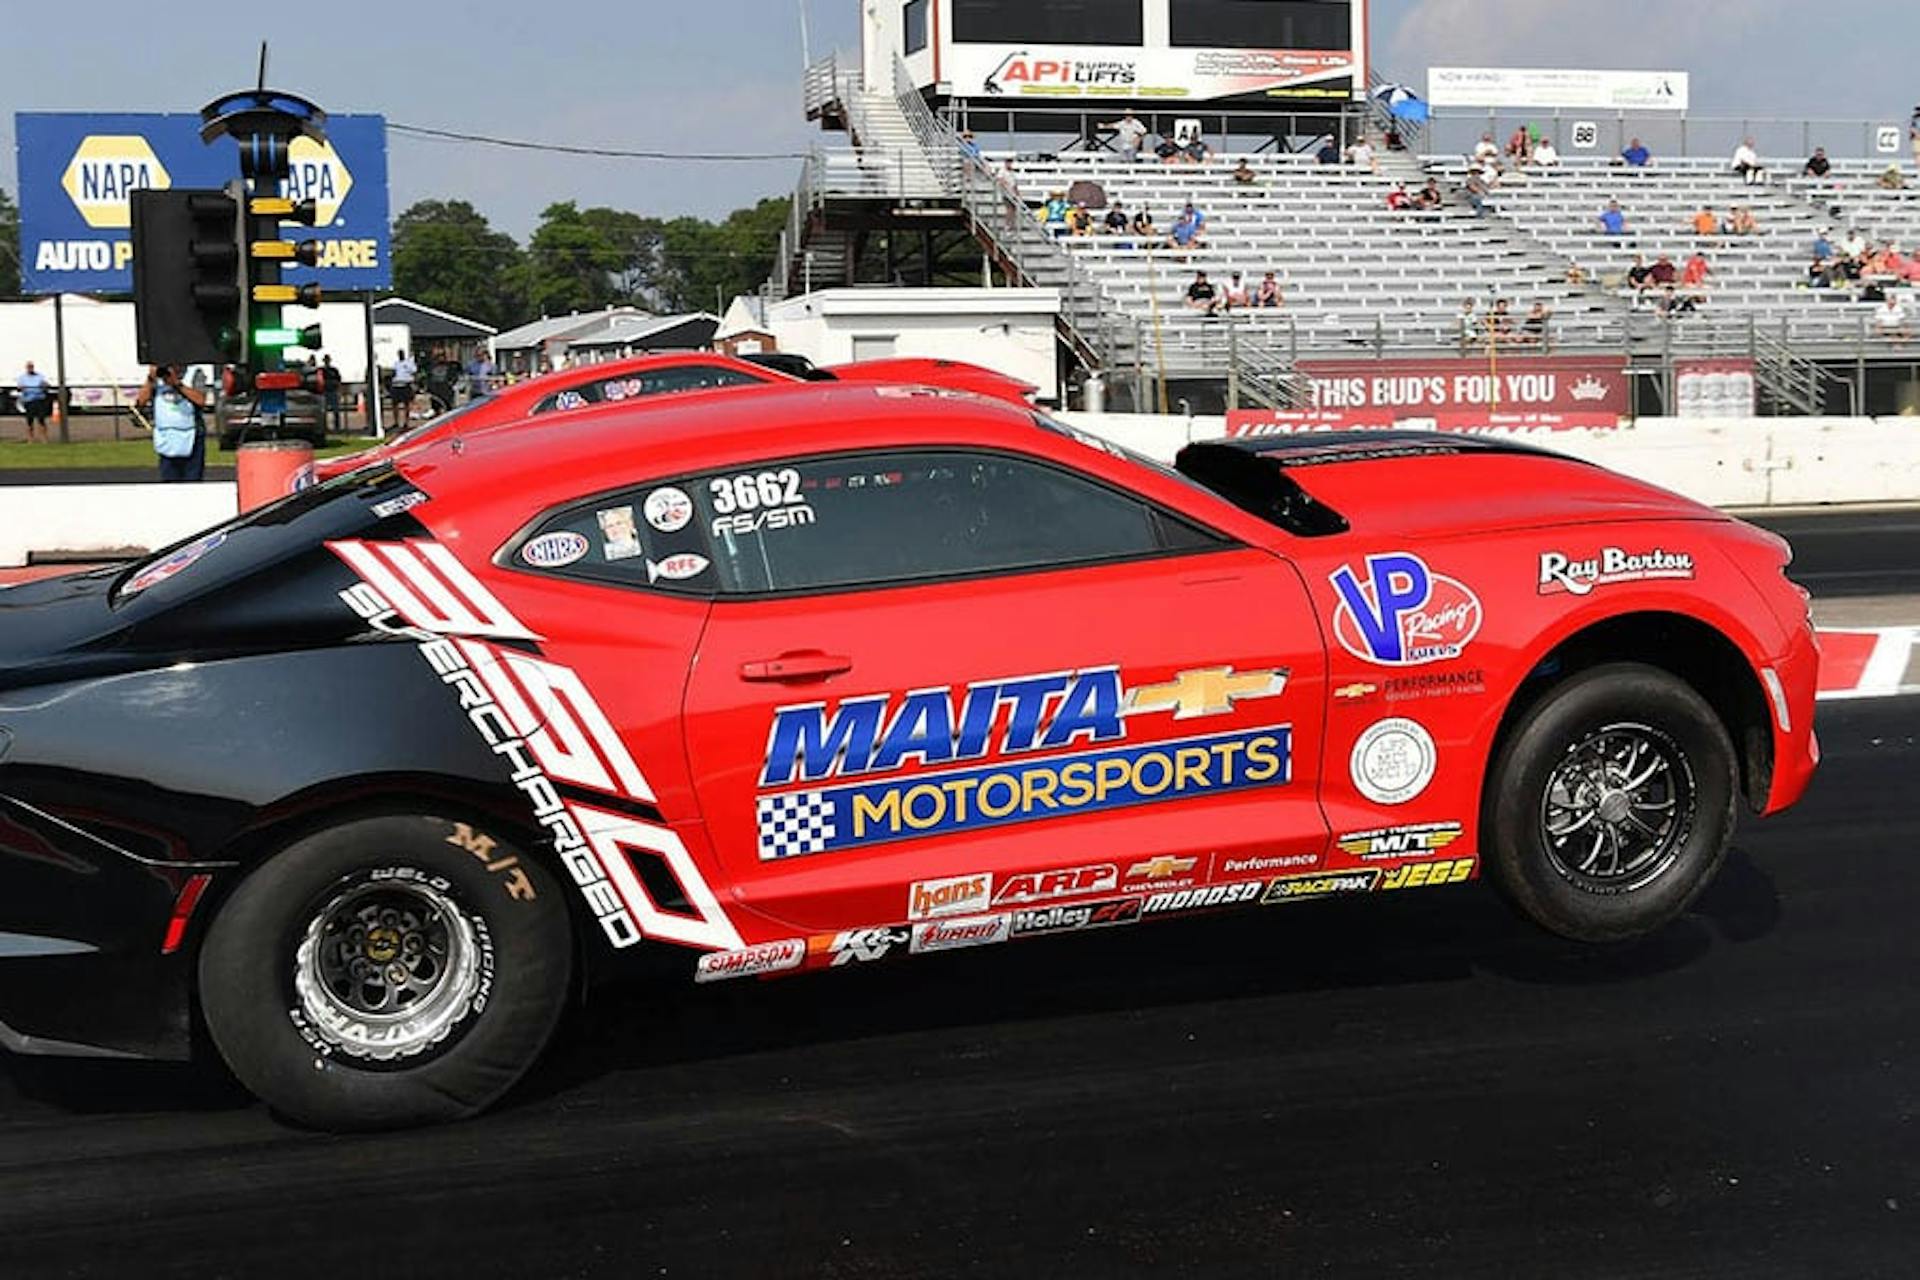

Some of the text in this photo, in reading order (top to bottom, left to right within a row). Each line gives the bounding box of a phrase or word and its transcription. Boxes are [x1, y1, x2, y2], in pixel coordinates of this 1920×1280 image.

[1075, 61, 1136, 71] SUPPLY
[1075, 70, 1136, 84] LIFTS
[82, 163, 151, 200] NAPA
[287, 163, 335, 199] APA
[36, 240, 109, 270] AUTO
[1308, 374, 1556, 406] THIS BUD'S FOR YOU
[709, 468, 805, 514] 3662
[1540, 551, 1601, 596] Ray
[1602, 547, 1695, 571] Barton
[1328, 551, 1432, 665] VP
[1404, 600, 1478, 648] Racing
[1384, 670, 1484, 691] PERFORMANCE
[757, 666, 1125, 788] MAITA
[338, 582, 642, 950] SUPERCHARGED
[852, 736, 1280, 838] MOTORSPORTS
[1371, 832, 1430, 853] M/T
[447, 821, 538, 901] M/T
[1223, 854, 1318, 872] Performance
[1383, 858, 1475, 889] JEGS
[371, 866, 452, 891] WELD
[999, 866, 1118, 902] ARP
[914, 877, 985, 916] hans
[1143, 880, 1263, 913] MOROSO
[1015, 907, 1092, 931] Holley
[707, 943, 796, 974] SIMPSON
